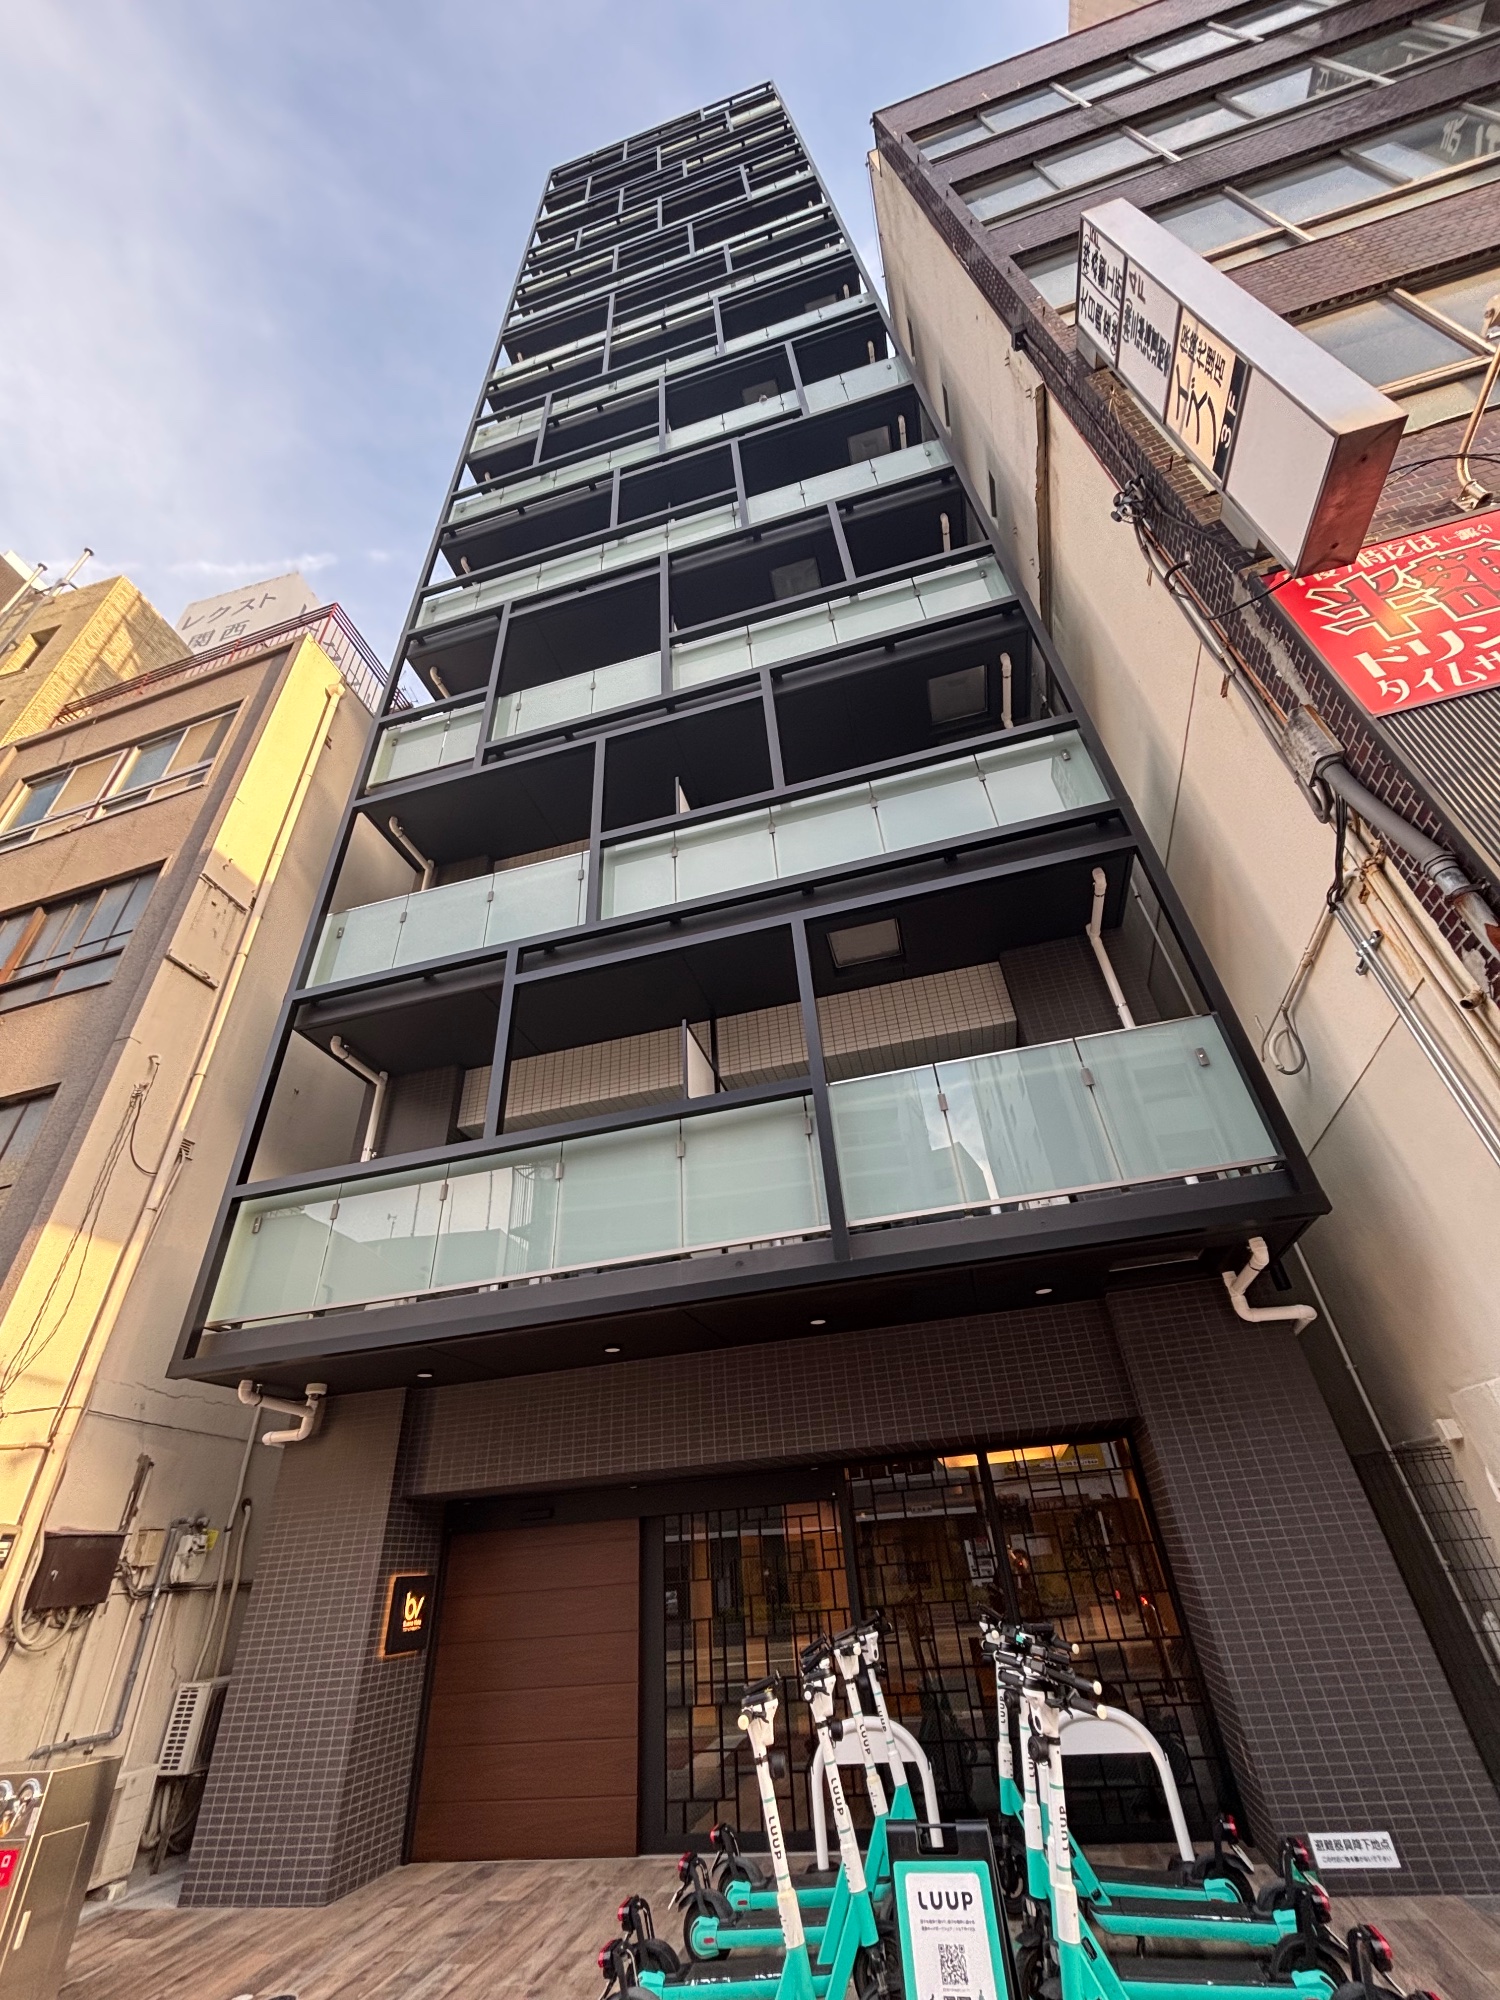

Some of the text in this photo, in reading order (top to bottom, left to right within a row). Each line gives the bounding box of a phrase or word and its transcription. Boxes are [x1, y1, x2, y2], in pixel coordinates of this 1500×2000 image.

[1129, 271, 1146, 305] 4F
[1180, 324, 1226, 388] 保険代理店
[1284, 534, 1440, 586] 時迄は
[182, 593, 276, 630] レクスト
[188, 619, 250, 648] 関西
[877, 1704, 887, 1732] LUUP
[859, 1723, 871, 1755] LUUP
[831, 1777, 844, 1816] LUUP
[768, 1815, 781, 1860] LUUP
[1059, 1805, 1068, 1852] LUUP
[1314, 1838, 1392, 1852] 避難器具降下地点
[918, 1891, 973, 1911] LUUP
